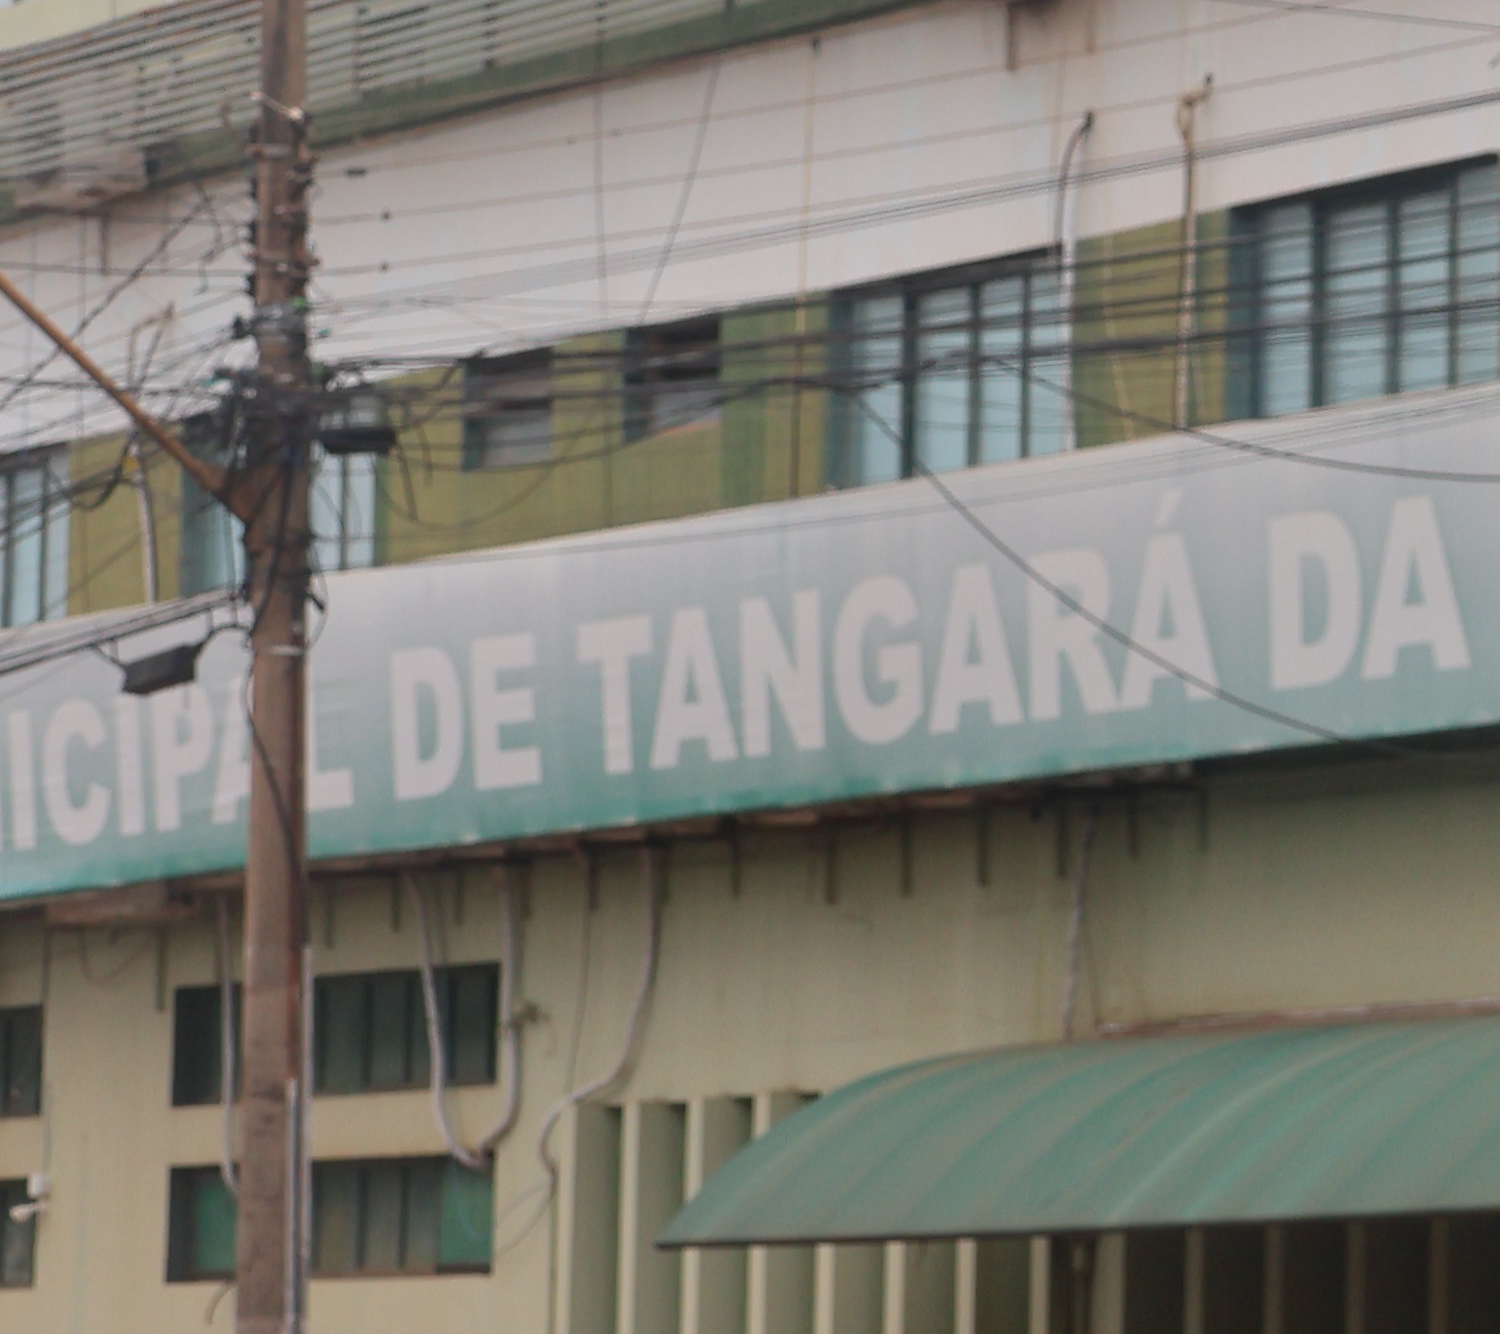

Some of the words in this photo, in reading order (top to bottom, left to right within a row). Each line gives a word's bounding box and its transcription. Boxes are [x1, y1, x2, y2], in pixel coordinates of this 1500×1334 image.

[0, 671, 354, 851] ICIPAL
[389, 632, 542, 800] DE
[576, 489, 1221, 776] TANGARÁ
[1268, 495, 1472, 690] DA
